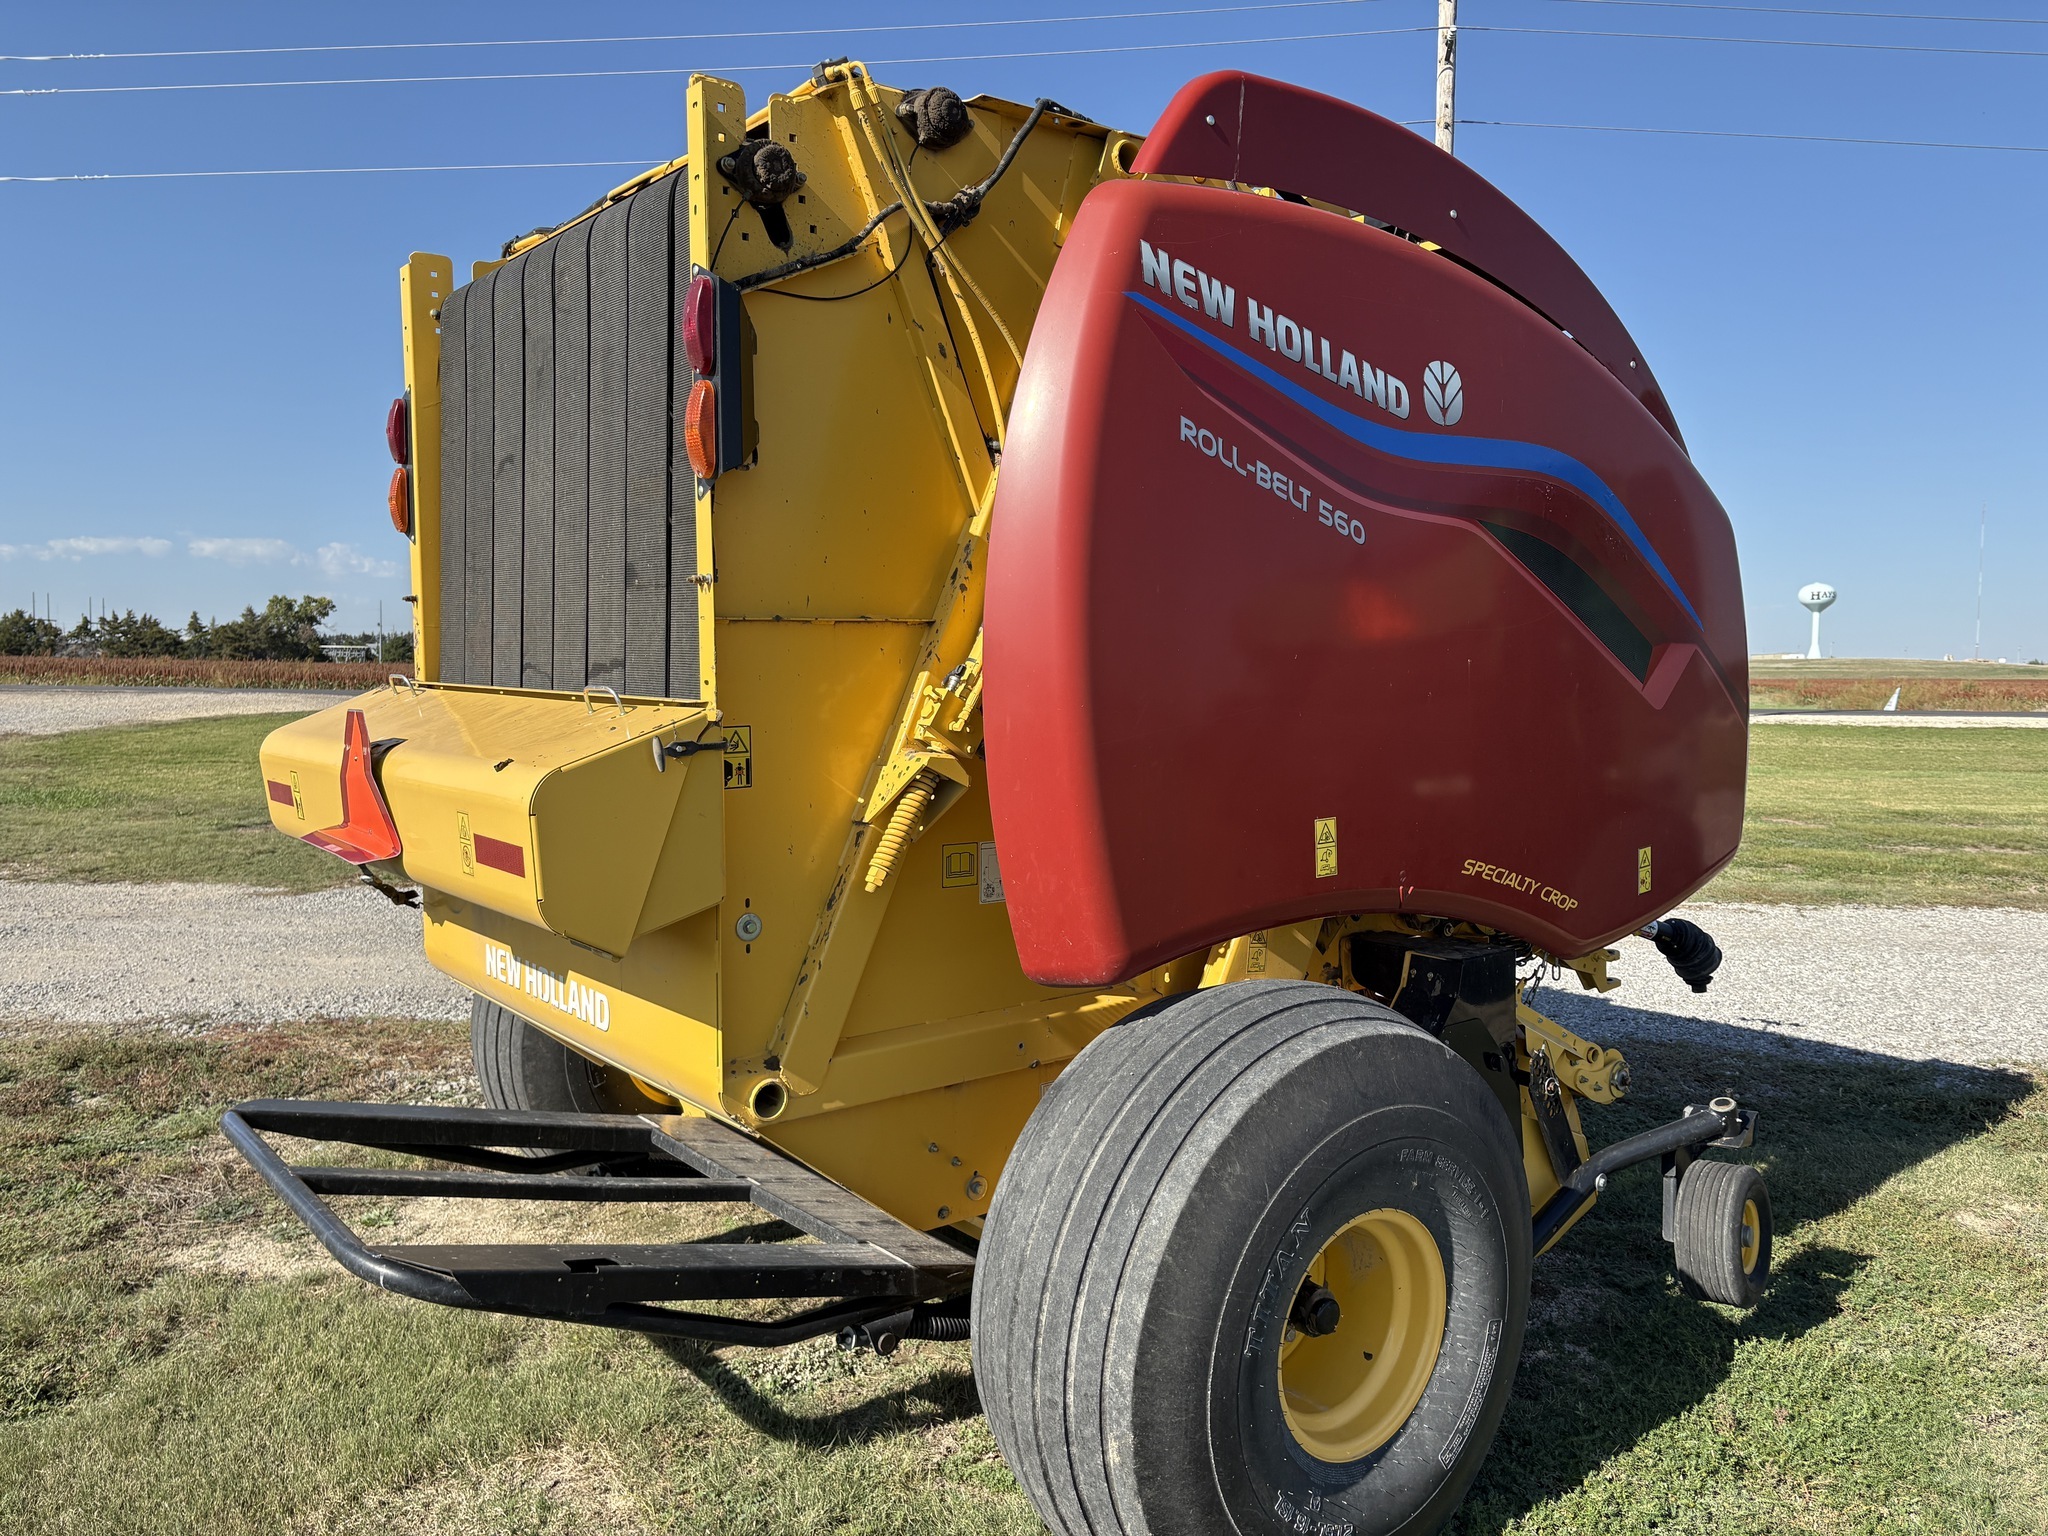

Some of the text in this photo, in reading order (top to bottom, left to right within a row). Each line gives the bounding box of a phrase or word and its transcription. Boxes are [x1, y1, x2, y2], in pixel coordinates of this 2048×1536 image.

[1139, 239, 1411, 420] NEW HOLLAND
[1180, 415, 1367, 545] ROLL-BELT 560
[1811, 591, 1836, 601] HAYS
[1461, 858, 1578, 911] SPECIALTY CROP
[485, 943, 611, 1032] NEW HOLLAND
[1400, 1148, 1434, 1164] FARM
[1434, 1155, 1476, 1196] SERVICE
[1243, 1207, 1312, 1358] TITAN
